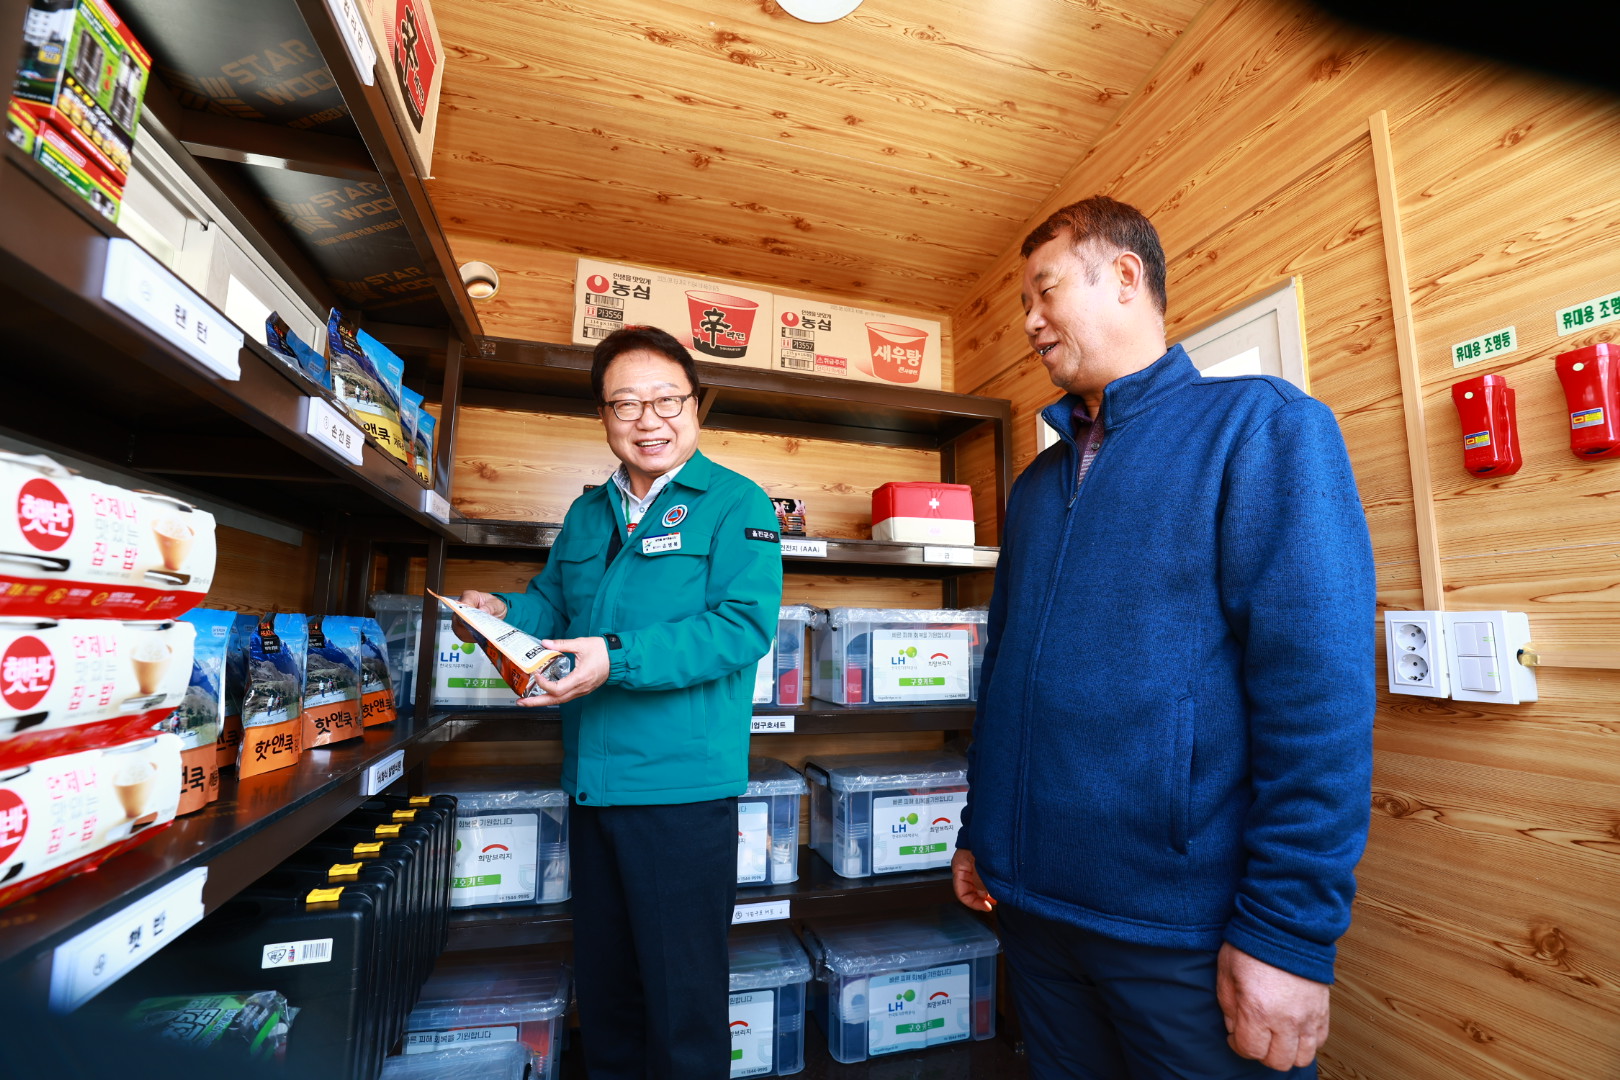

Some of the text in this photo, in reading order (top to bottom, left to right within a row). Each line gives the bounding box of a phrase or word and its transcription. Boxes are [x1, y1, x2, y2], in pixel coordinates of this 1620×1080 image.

[220, 38, 316, 86] STAR
[255, 66, 335, 106] WOO
[309, 181, 384, 209] STAR
[333, 196, 399, 222] WOO
[364, 266, 425, 286] STAR
[382, 277, 435, 295] WOO
[632, 276, 652, 286] 맛있게
[612, 280, 651, 300] 농심
[700, 307, 732, 349] 辛
[801, 315, 832, 332] 농심
[1562, 305, 1595, 330] 휴대용
[873, 344, 922, 367] 새우탕
[1456, 331, 1511, 362] 휴대용 조명등
[363, 423, 391, 445] 앤쿡
[20, 494, 72, 537] 햇반
[91, 492, 138, 523] 언제나
[800, 545, 820, 553] (AAA)
[72, 634, 118, 659] 언제나
[440, 651, 460, 663] LH
[891, 656, 906, 665] LH
[2, 655, 54, 695] 햇반
[314, 710, 353, 735] 핫앤쿡
[255, 733, 294, 762] 핫앤쿡
[47, 767, 98, 800] 언제나
[0, 803, 27, 849] 반
[480, 817, 513, 827] 기원합니다
[892, 824, 907, 833] LH
[478, 853, 512, 862] 희망브리지
[729, 995, 753, 1005] 원합니다
[888, 1001, 903, 1013] LH
[419, 1035, 433, 1043] 피해
[456, 1030, 492, 1041] 기원합니다
[731, 1028, 752, 1039] 브리지
